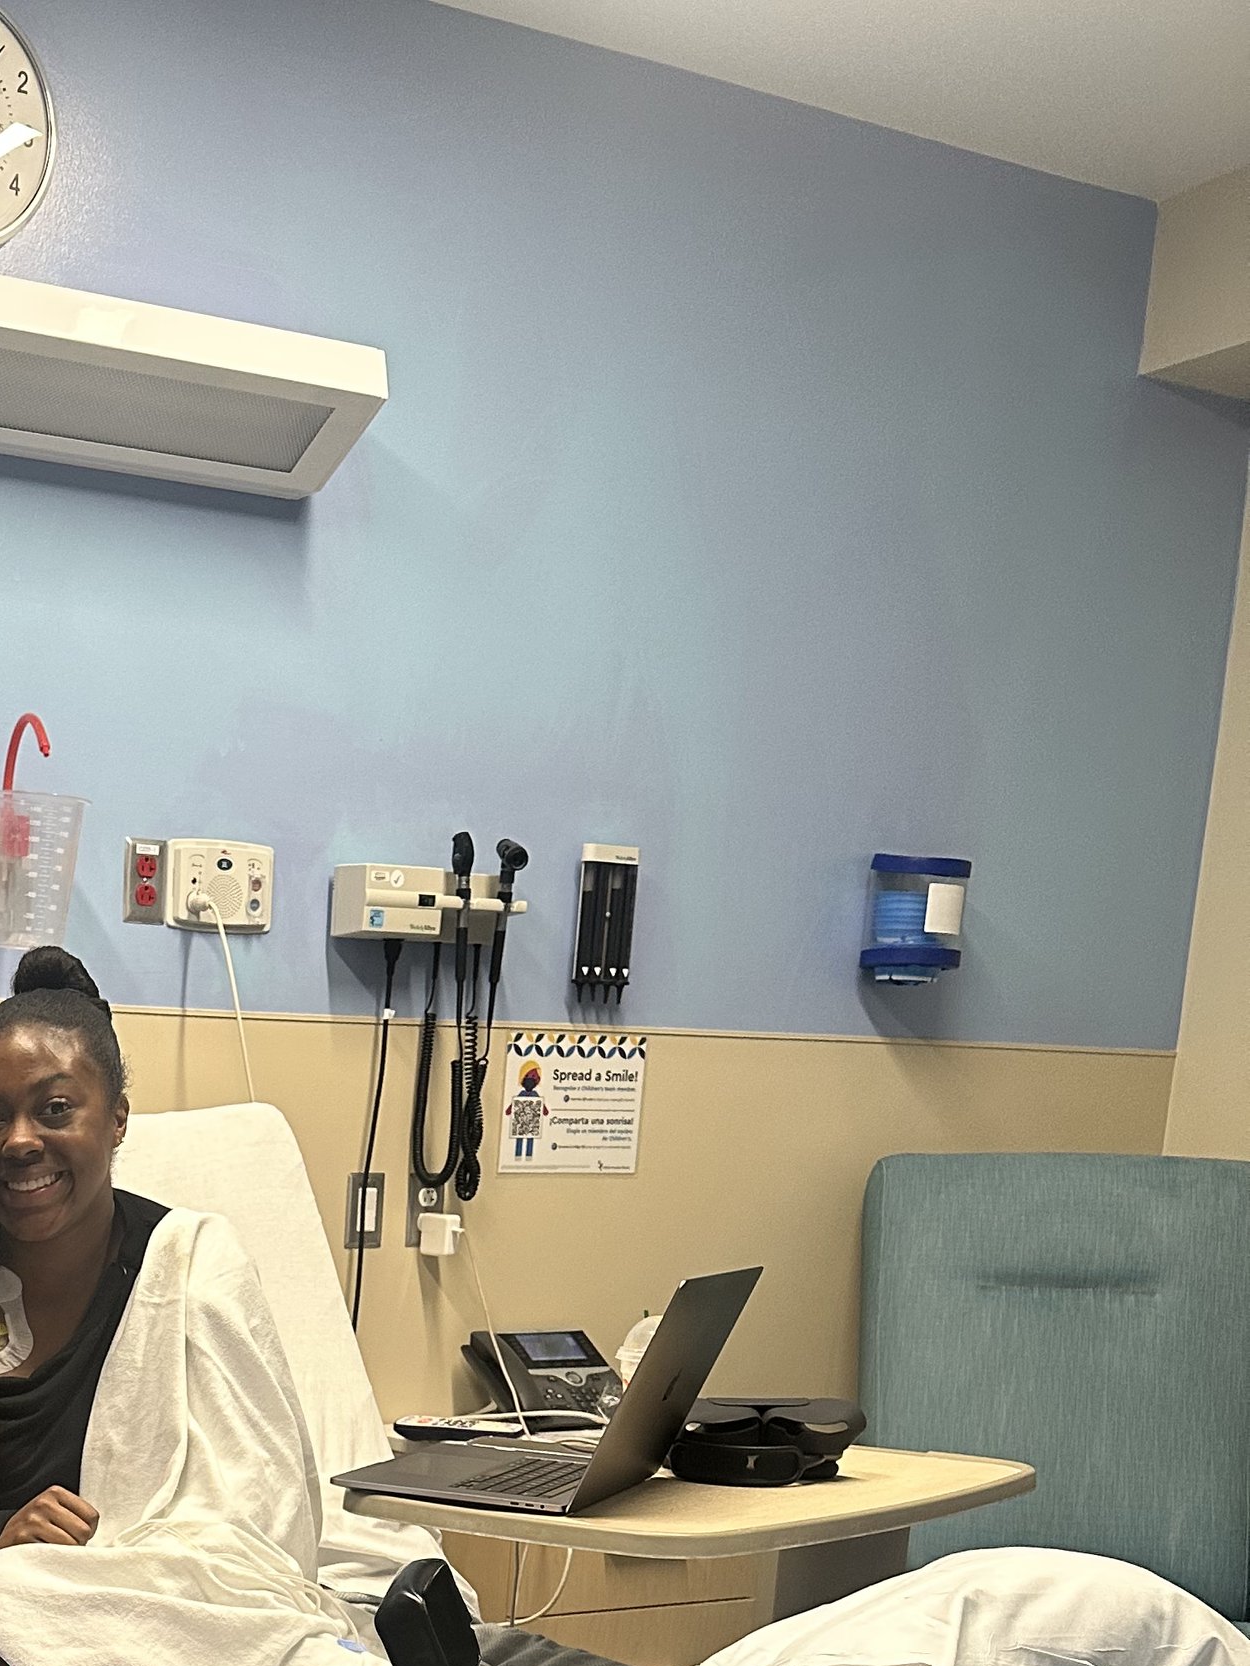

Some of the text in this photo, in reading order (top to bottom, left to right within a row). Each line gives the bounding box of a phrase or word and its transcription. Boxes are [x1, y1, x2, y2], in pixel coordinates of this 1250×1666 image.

[17, 71, 28, 95] 2
[9, 174, 20, 196] 4
[552, 1068, 639, 1083] Spread a Smile!
